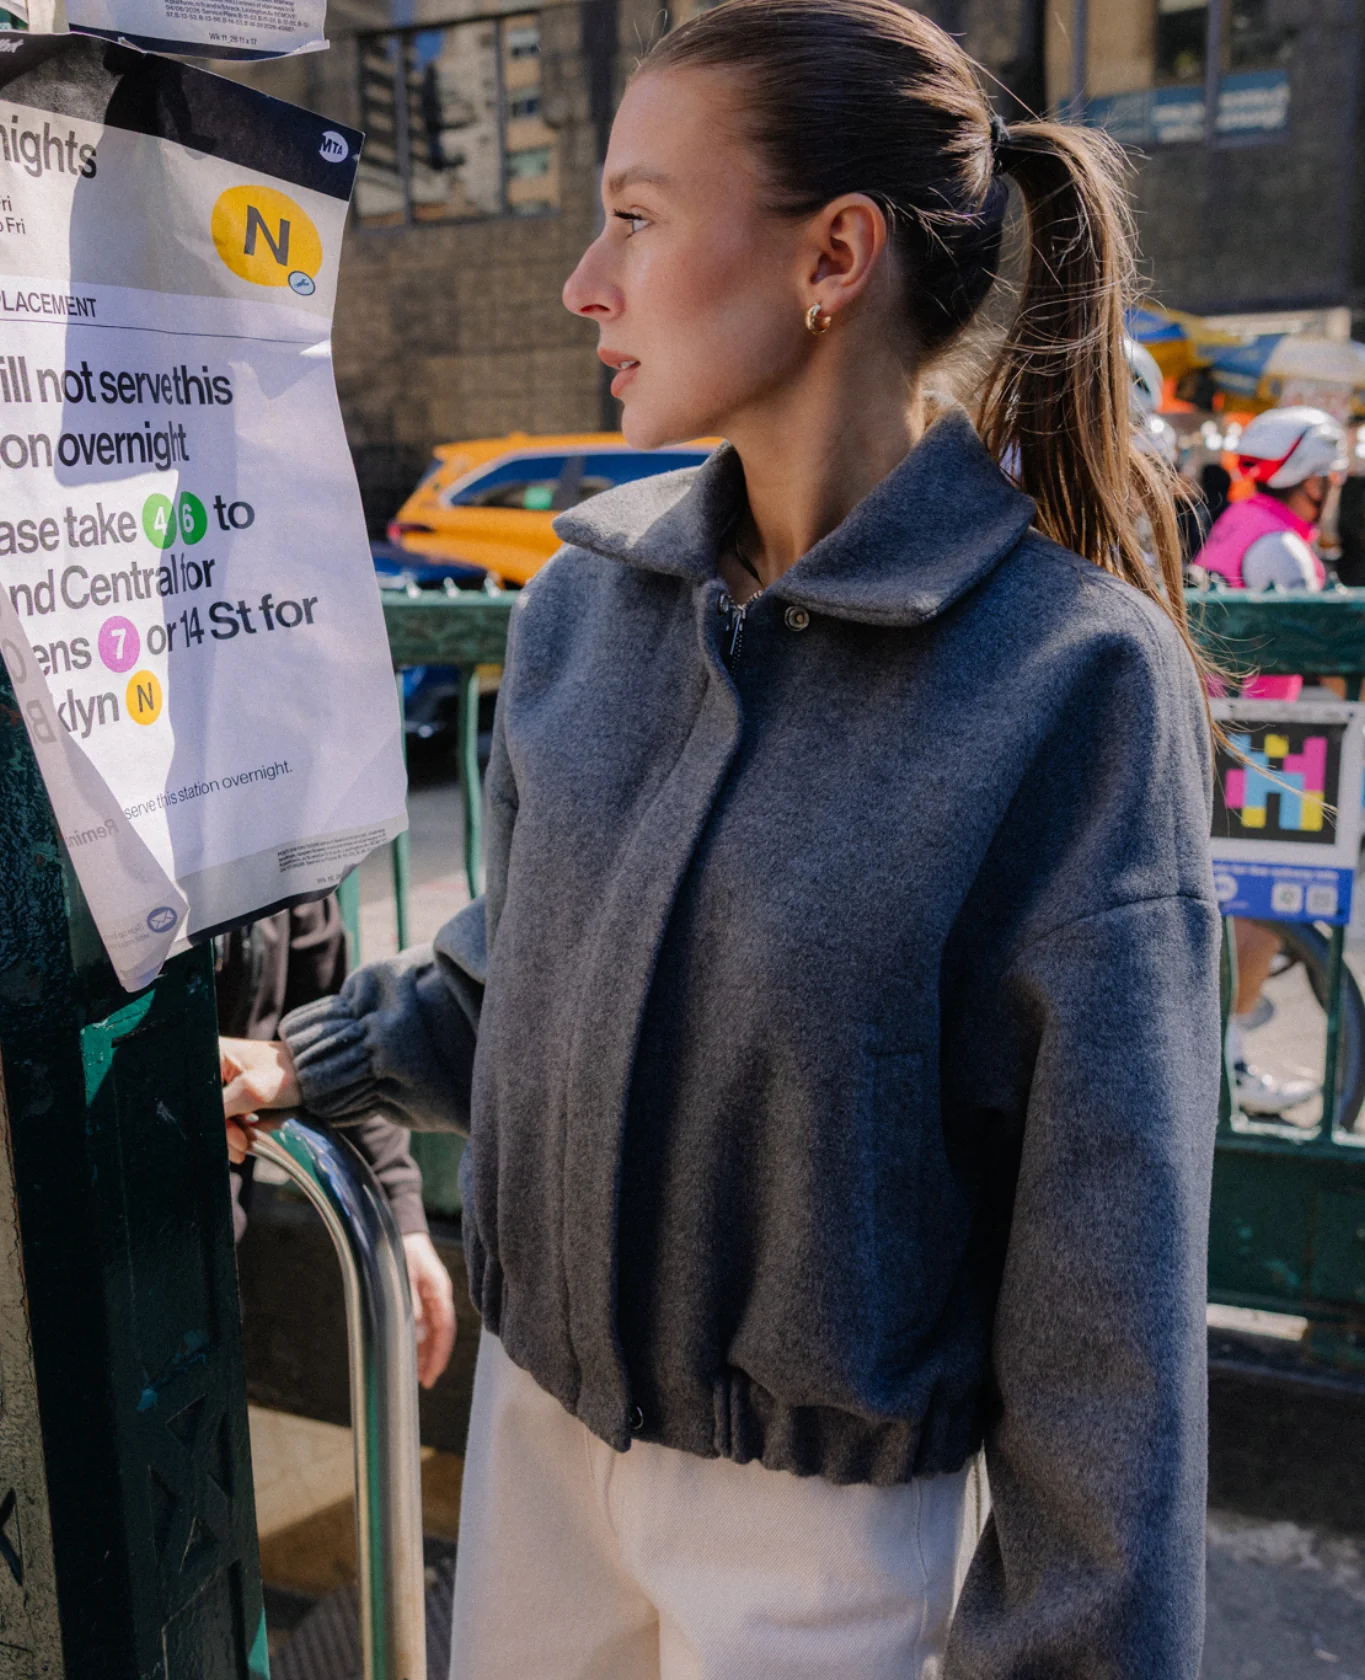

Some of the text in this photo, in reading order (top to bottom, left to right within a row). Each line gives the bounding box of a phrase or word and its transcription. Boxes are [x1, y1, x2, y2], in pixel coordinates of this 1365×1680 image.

[208, 32, 220, 40] Wk
[322, 138, 343, 156] MTA
[0, 195, 12, 212] ri
[6, 217, 26, 234] Fri
[244, 204, 291, 267] N
[0, 290, 97, 318] LACEMENT
[36, 361, 97, 404] not
[58, 421, 190, 472] overnight
[64, 502, 137, 548] take
[214, 495, 255, 531] to
[9, 552, 215, 616] nd Central for
[146, 621, 177, 656] or
[180, 607, 205, 649] 14
[208, 600, 257, 642] St
[258, 593, 318, 632] for
[124, 760, 293, 821] serve this station overnight.
